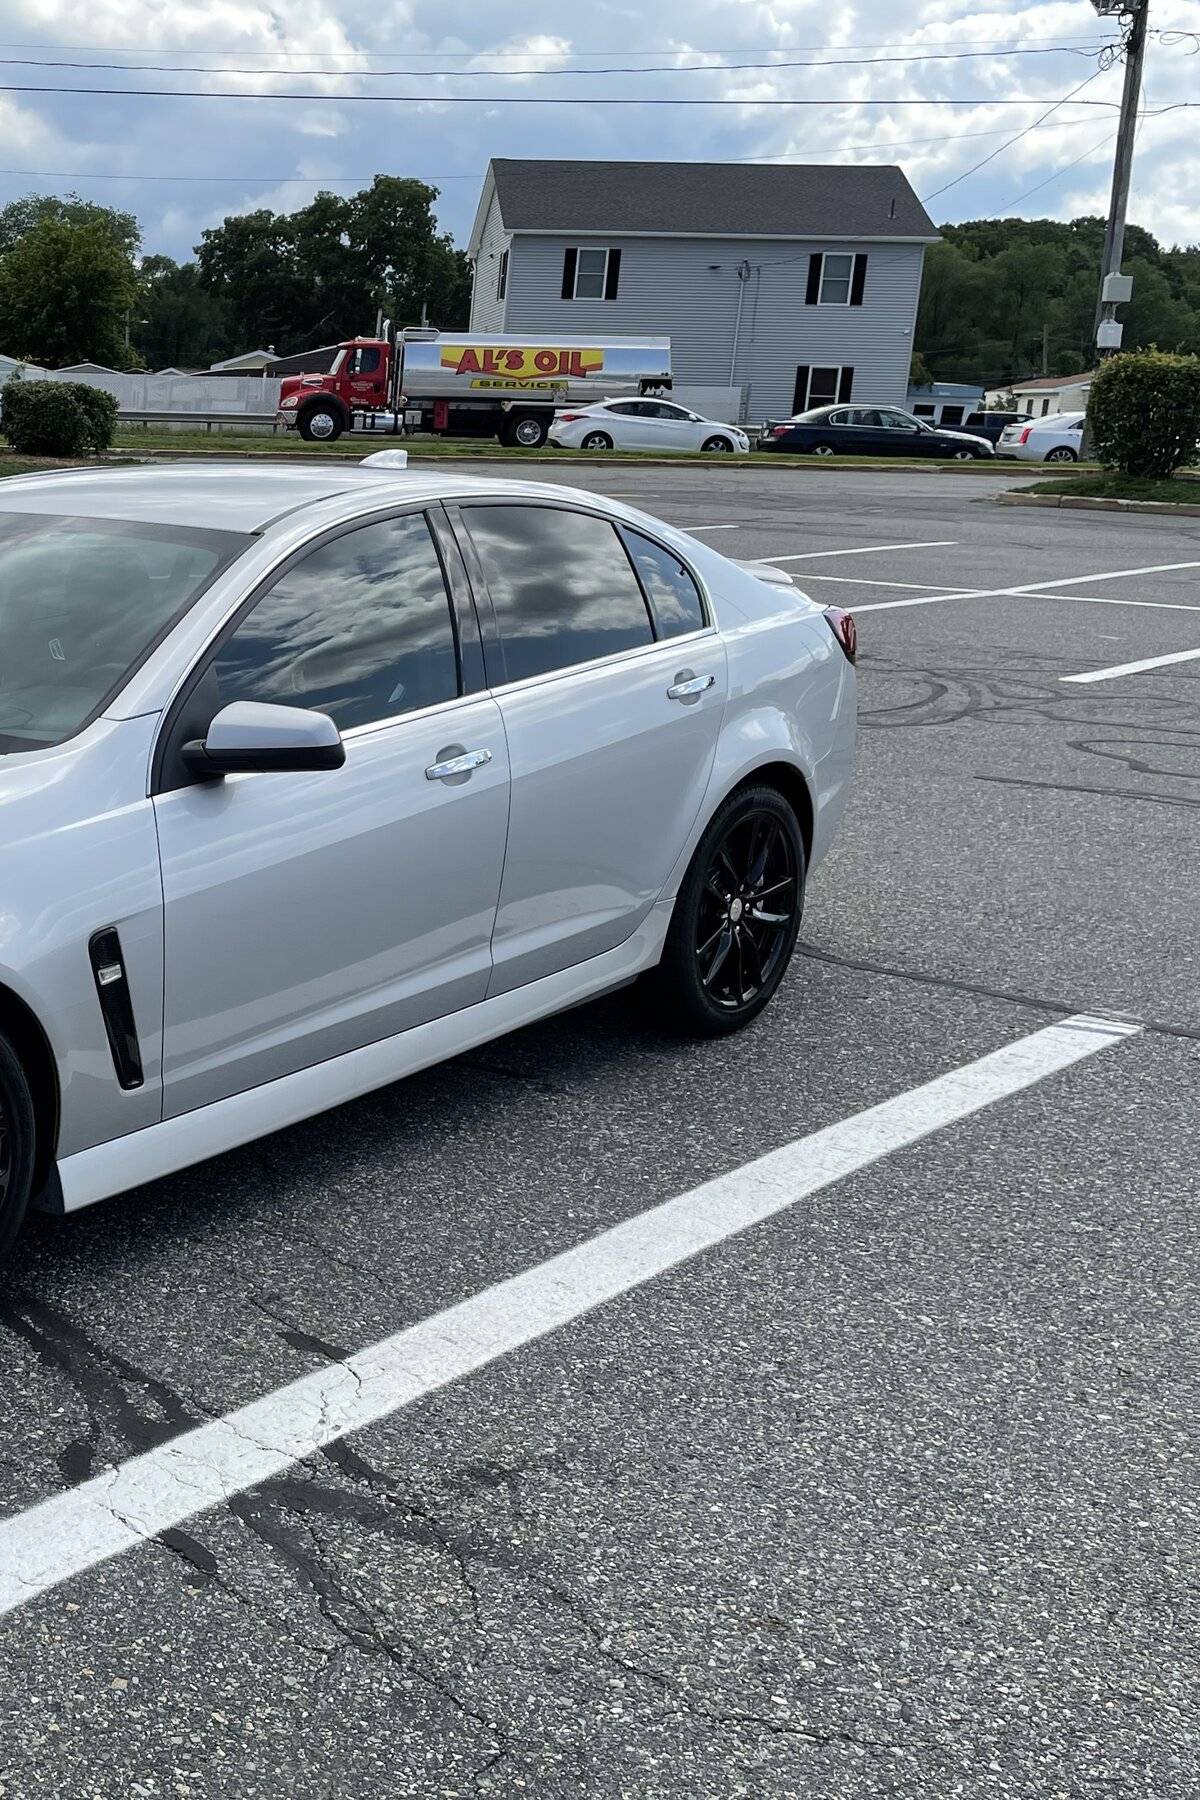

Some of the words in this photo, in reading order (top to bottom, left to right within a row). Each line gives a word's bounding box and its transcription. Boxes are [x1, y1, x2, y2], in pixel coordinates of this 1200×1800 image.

[456, 349, 524, 375] AL'S
[534, 350, 587, 378] OIL
[479, 380, 560, 389] SERVICE
